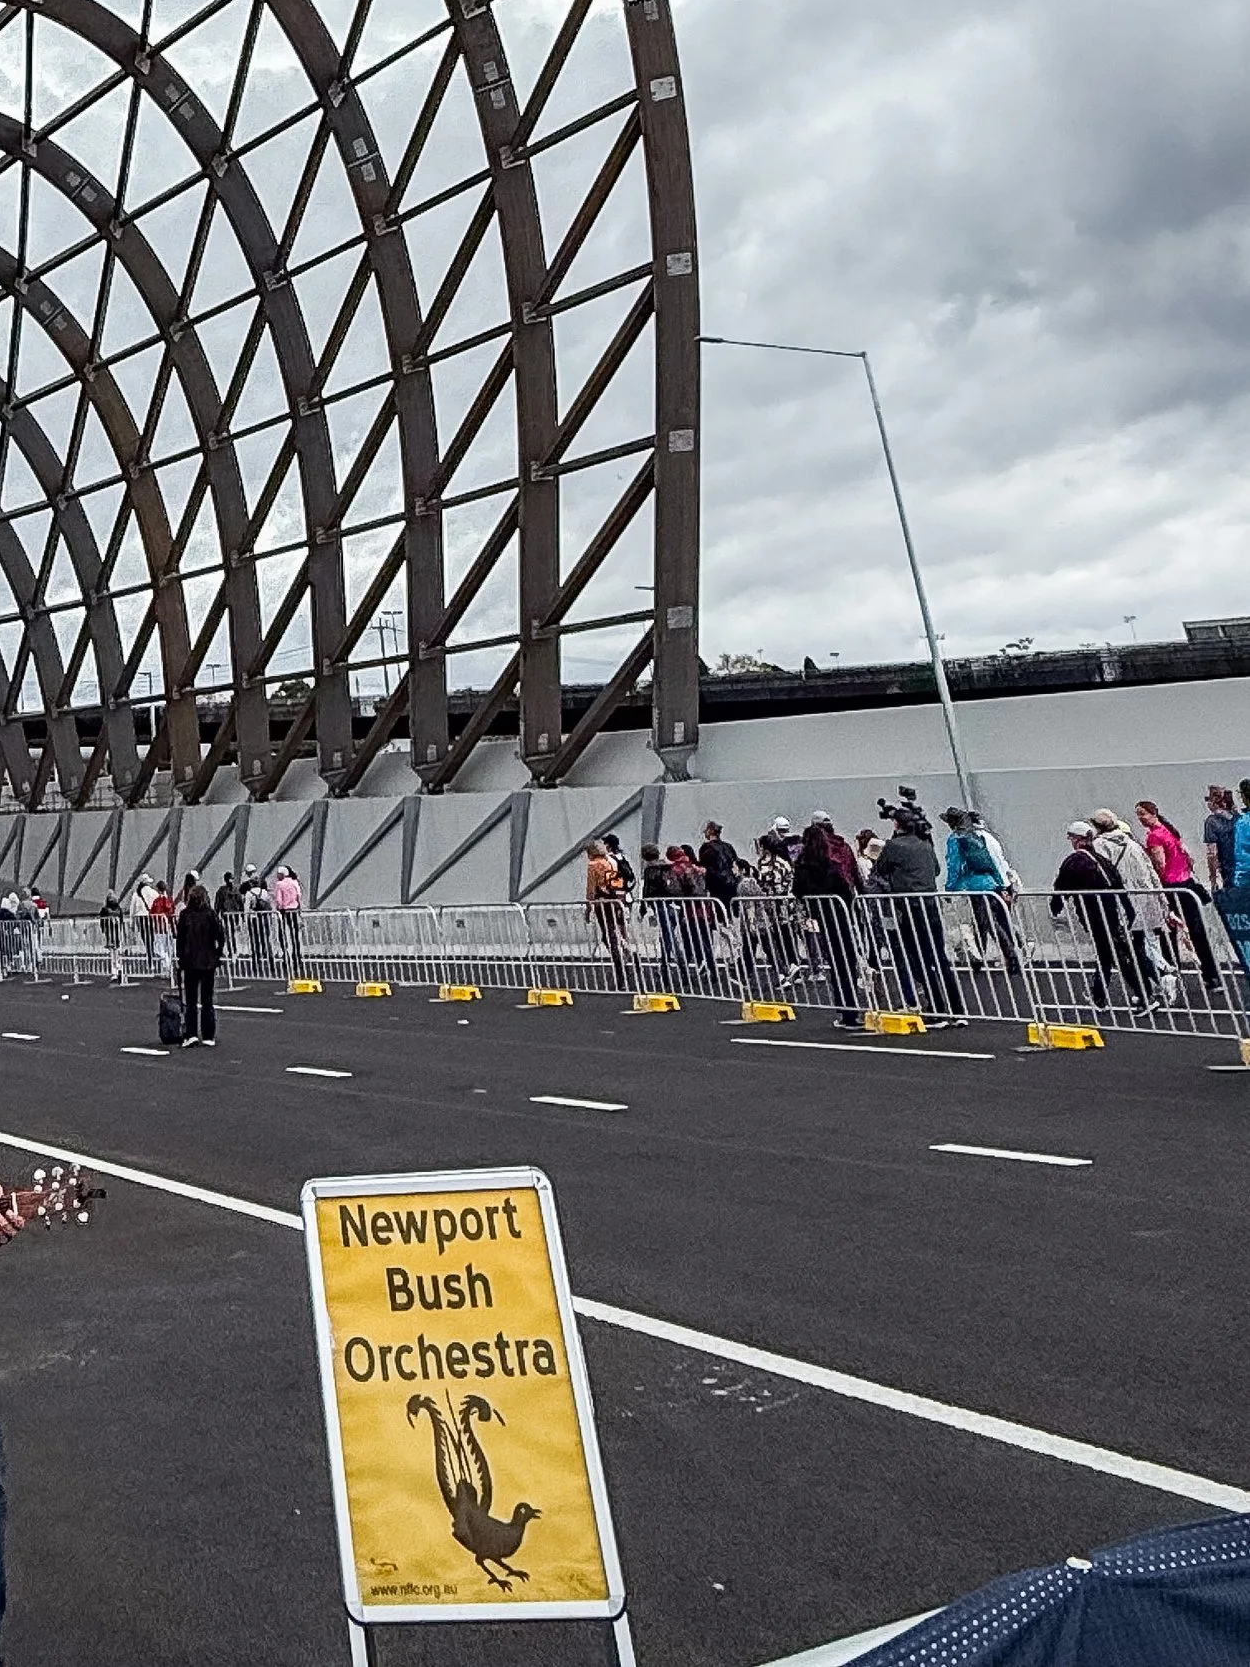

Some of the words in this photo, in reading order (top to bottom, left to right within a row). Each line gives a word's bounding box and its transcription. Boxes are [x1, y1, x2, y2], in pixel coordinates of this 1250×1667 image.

[340, 1197, 522, 1255] Newport
[386, 1263, 493, 1312] Bush
[344, 1331, 557, 1382] Orchestra
